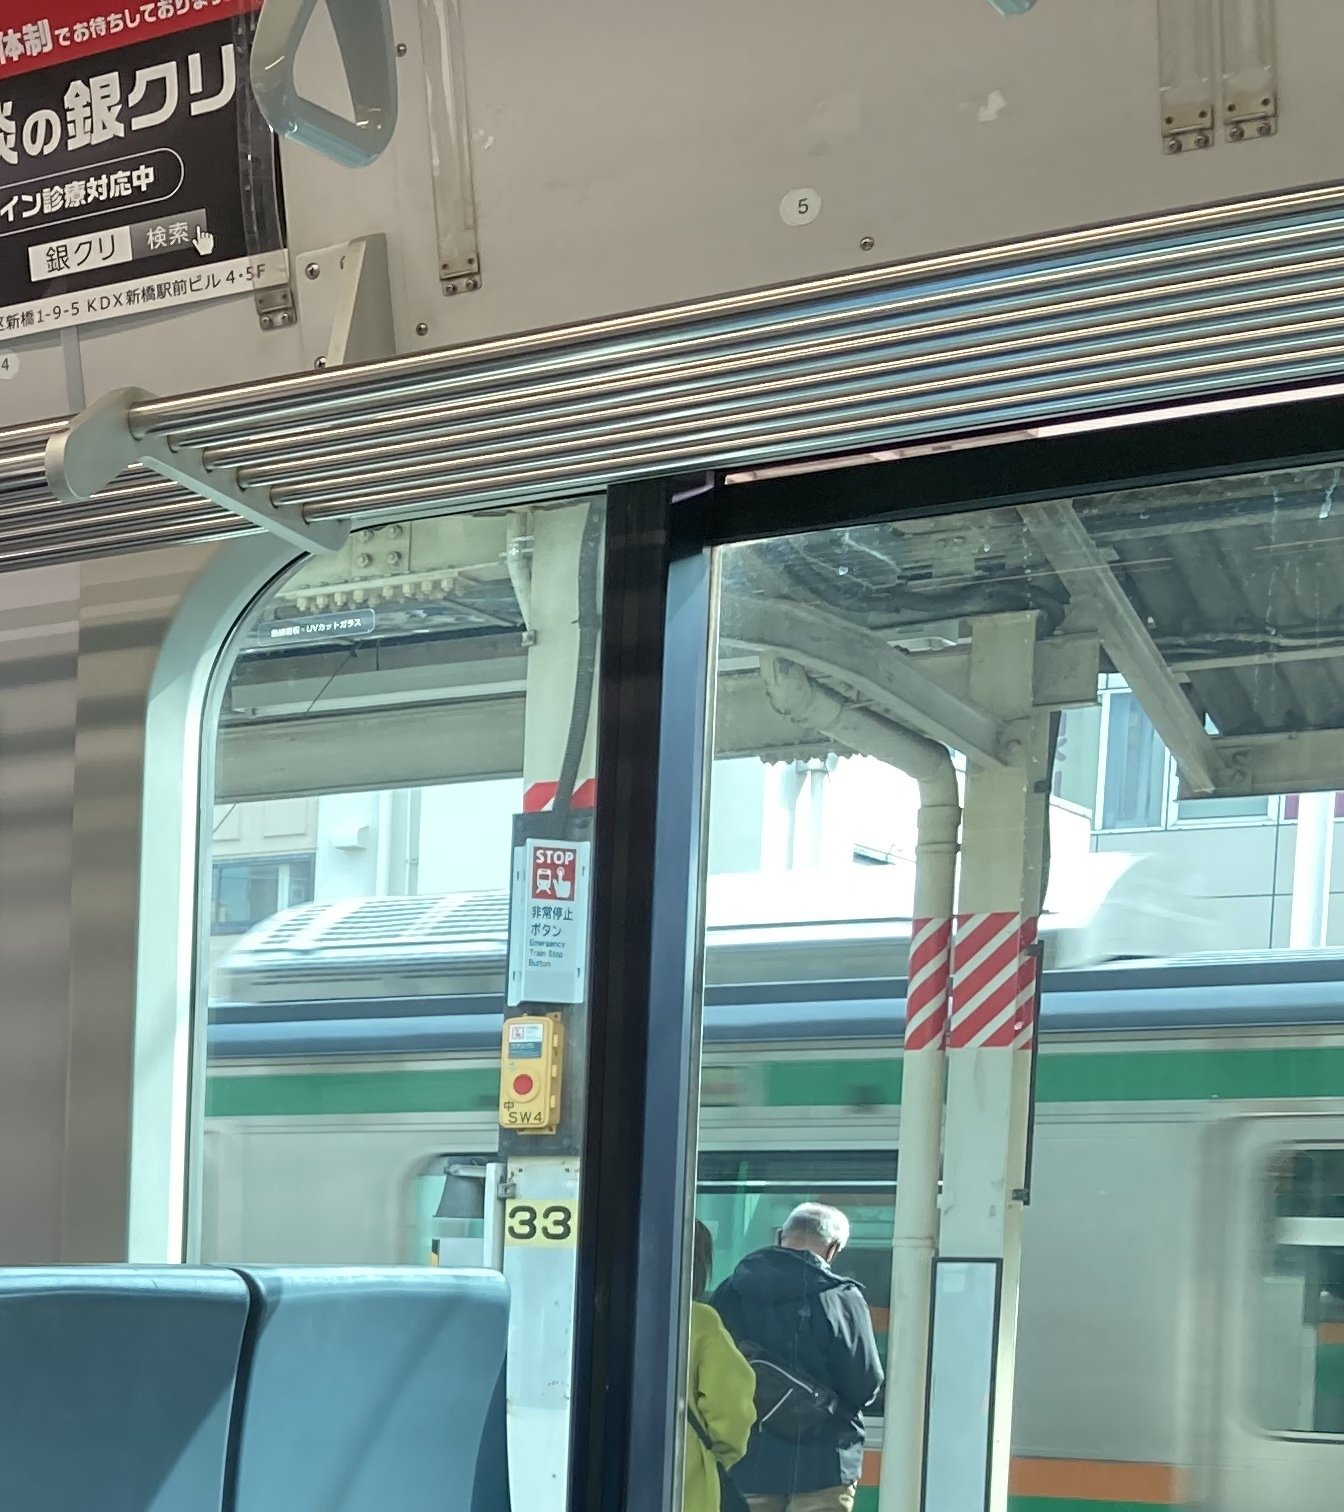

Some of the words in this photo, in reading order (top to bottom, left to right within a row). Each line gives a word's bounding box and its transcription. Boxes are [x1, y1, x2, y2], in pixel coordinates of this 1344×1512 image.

[798, 197, 809, 215] 5
[146, 221, 190, 251] 検索
[45, 234, 116, 273] 銀クリ
[87, 273, 221, 313] KDX新橋駅前ビル
[1, 357, 10, 371] 4
[535, 849, 574, 865] STOP
[531, 905, 574, 921] 非常停止
[530, 922, 562, 938] ボタン
[528, 939, 566, 949] Emergency
[548, 949, 564, 959] Stop
[528, 958, 552, 968] Button
[507, 1110, 544, 1124] SW4
[507, 1204, 573, 1241] 33
